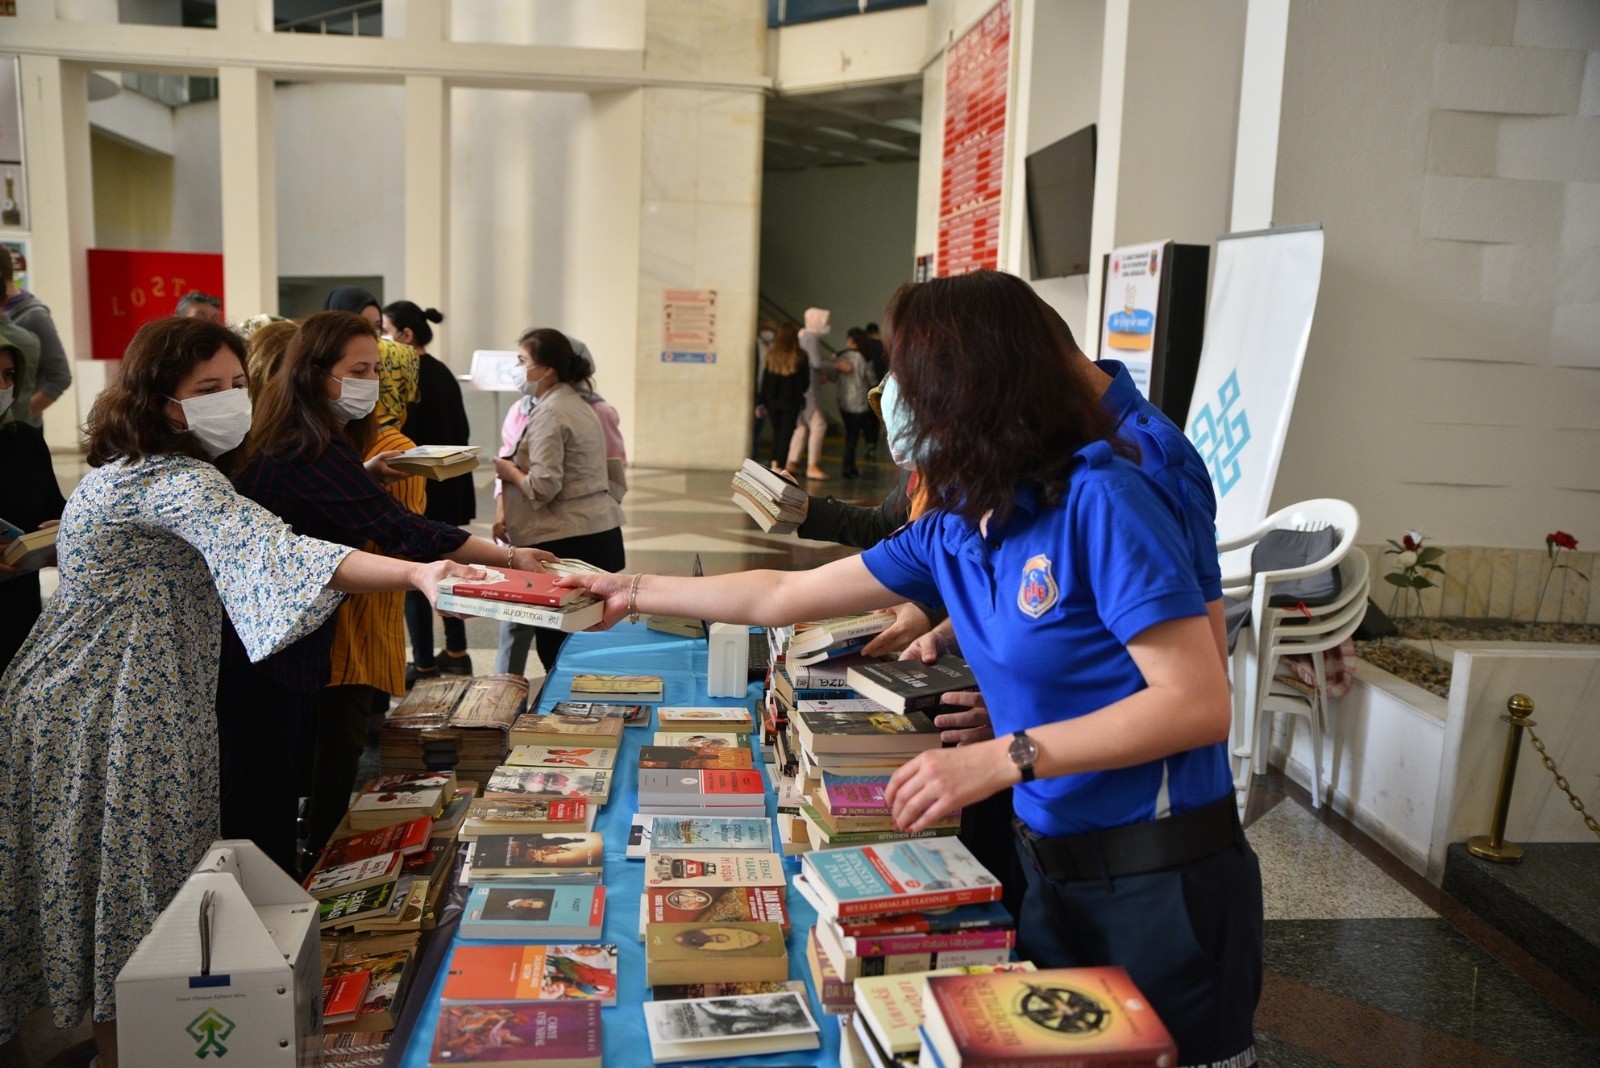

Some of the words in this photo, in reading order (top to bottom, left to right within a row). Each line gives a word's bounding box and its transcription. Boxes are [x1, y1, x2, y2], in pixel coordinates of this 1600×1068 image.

[720, 865, 735, 881] DÜŞÜN
[745, 856, 758, 881] YABANCI
[759, 859, 773, 879] SERHAT
[346, 890, 367, 914] ÇEKİM
[572, 898, 582, 912] FAUST
[762, 890, 779, 902] DAN
[845, 903, 869, 912] BEYAZ
[870, 899, 909, 911] ZAMBAKLAR
[910, 894, 950, 907] ÜLKESİNDE
[327, 894, 350, 919] YASASI
[825, 984, 839, 998] DA
